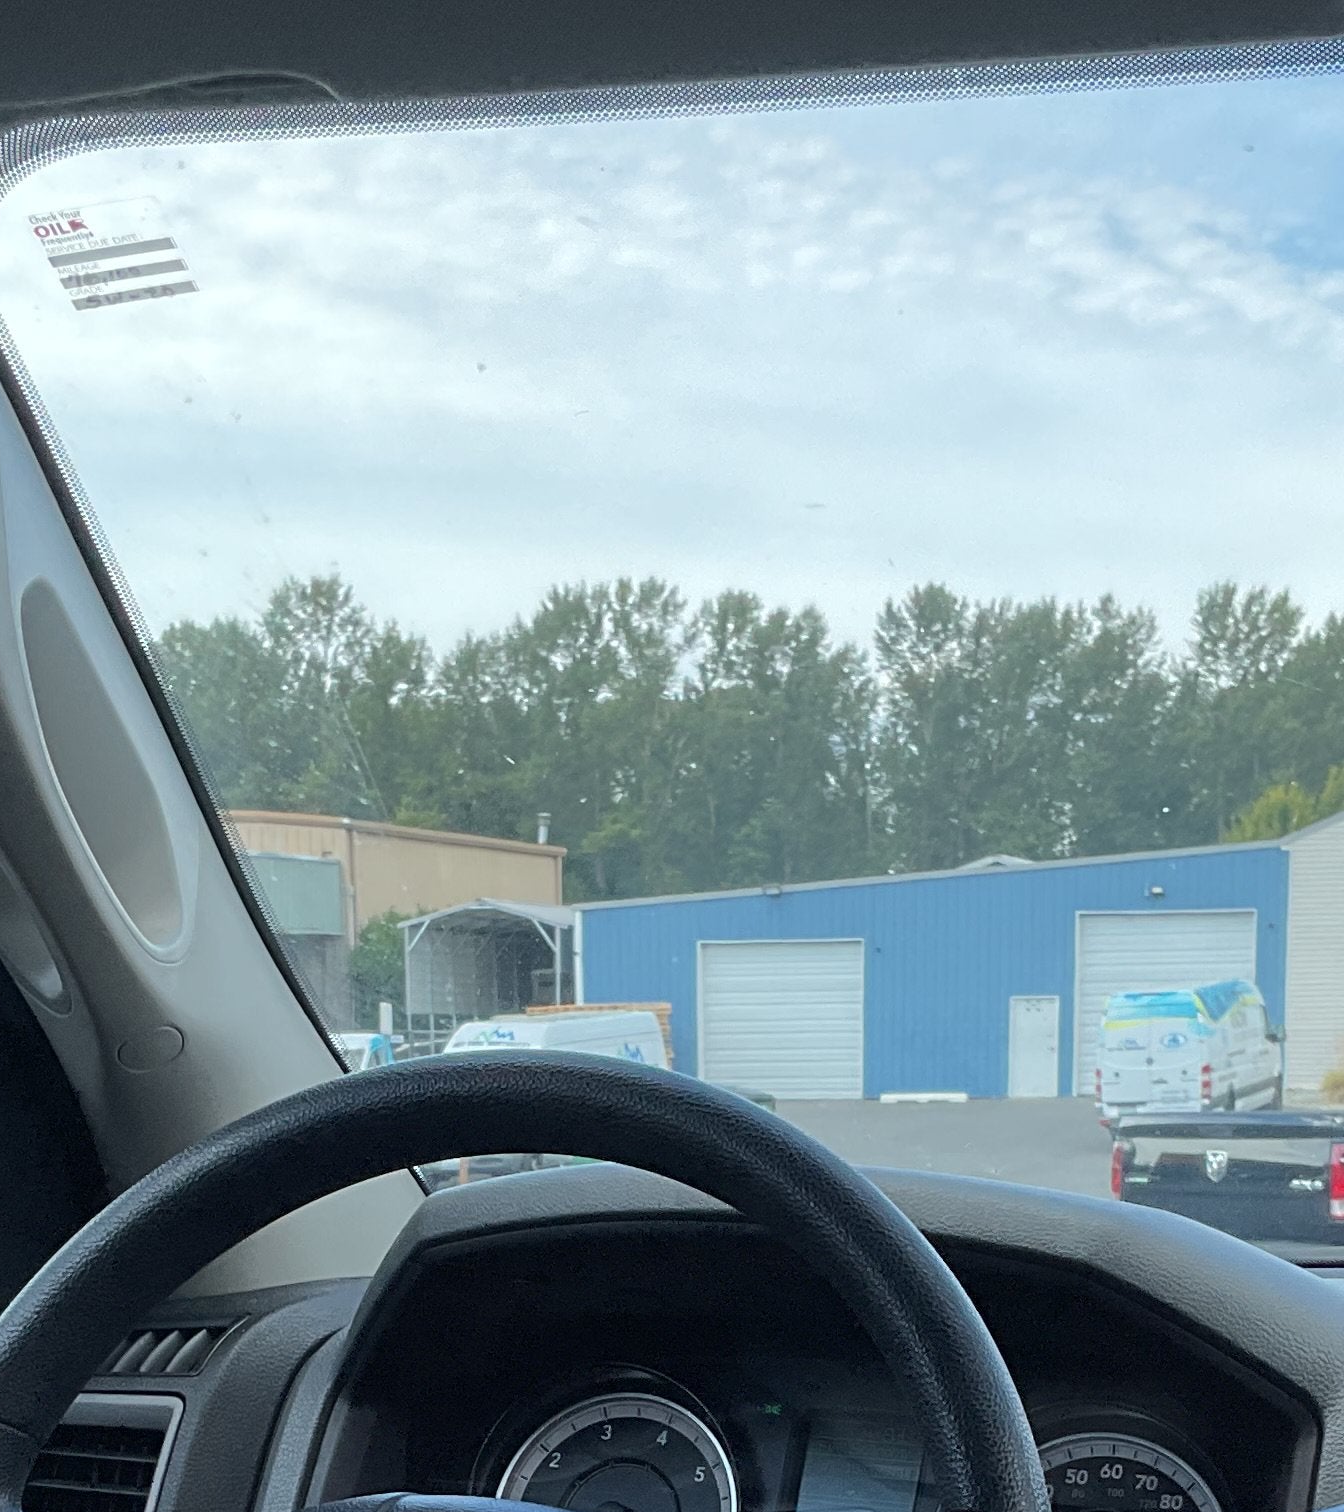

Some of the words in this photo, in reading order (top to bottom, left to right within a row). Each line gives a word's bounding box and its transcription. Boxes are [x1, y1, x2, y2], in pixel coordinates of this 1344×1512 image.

[29, 212, 57, 225] Check
[58, 210, 81, 220] Your
[33, 222, 70, 238] OIL
[45, 242, 85, 256] SERVICE
[88, 238, 109, 249] DUE
[58, 262, 101, 275] MILEAGE
[69, 286, 104, 298] GRADE
[601, 1425, 612, 1440] 3
[657, 1431, 668, 1445] 4
[549, 1452, 561, 1468] 2
[695, 1467, 706, 1482] 5
[1065, 1469, 1088, 1484] 50
[1100, 1464, 1123, 1479] 60
[1135, 1475, 1158, 1490] 70
[1160, 1494, 1183, 1510] 80
